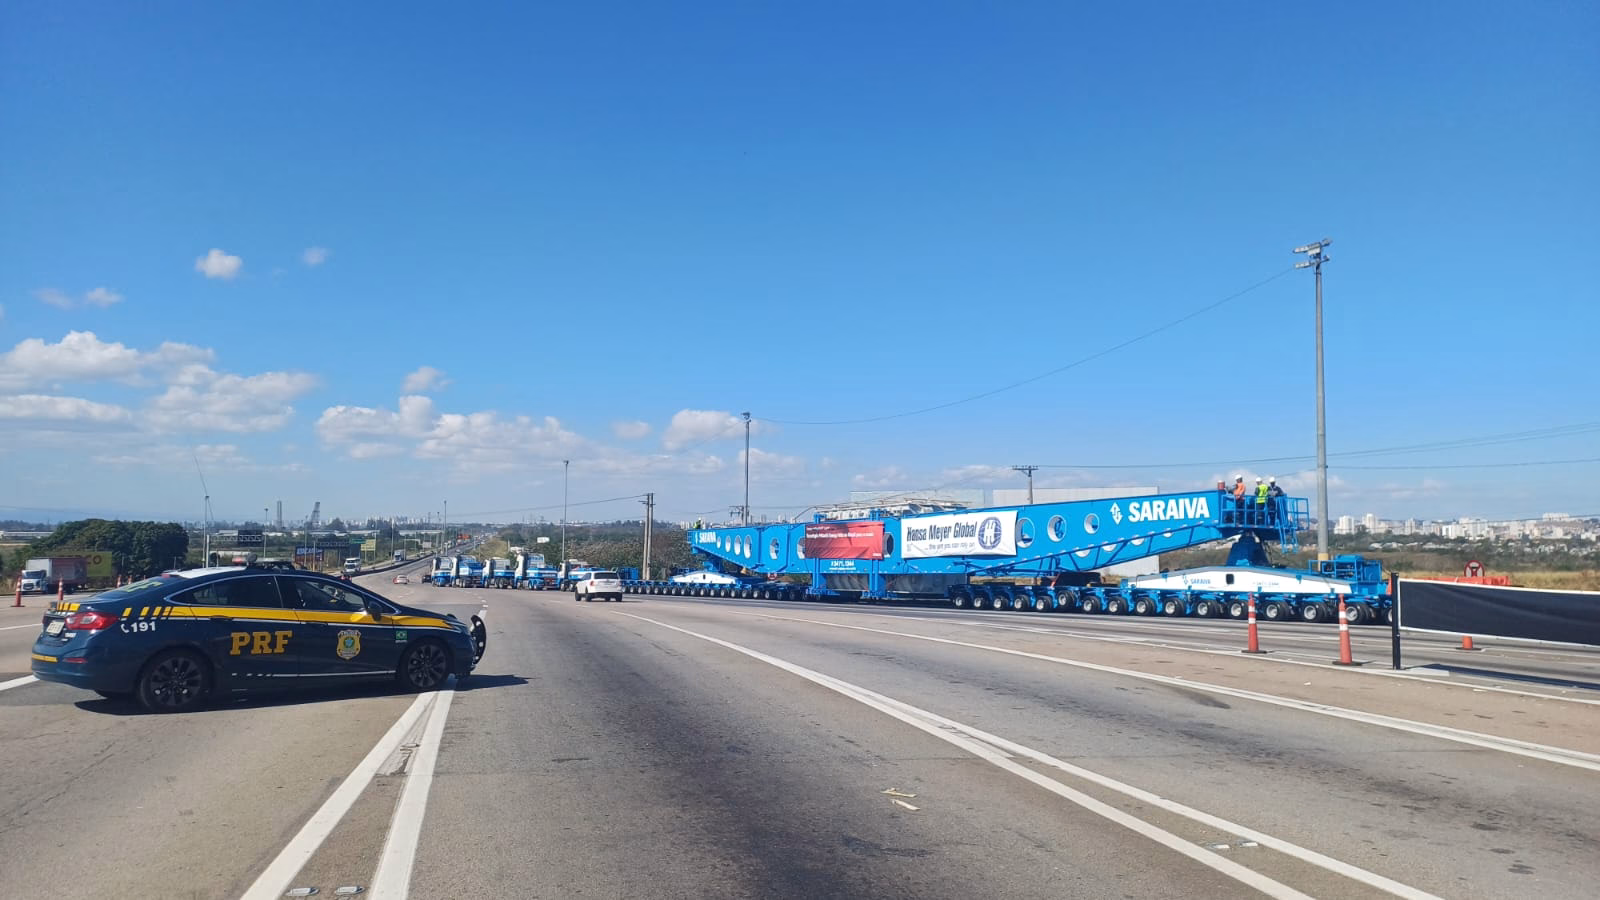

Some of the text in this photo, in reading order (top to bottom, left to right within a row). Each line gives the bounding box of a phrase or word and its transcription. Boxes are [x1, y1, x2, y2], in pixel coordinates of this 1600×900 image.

[1128, 497, 1210, 523] SARAIVA
[907, 521, 978, 542] Hansa Meyer Global
[131, 621, 157, 633] 191
[229, 630, 293, 656] PRF
